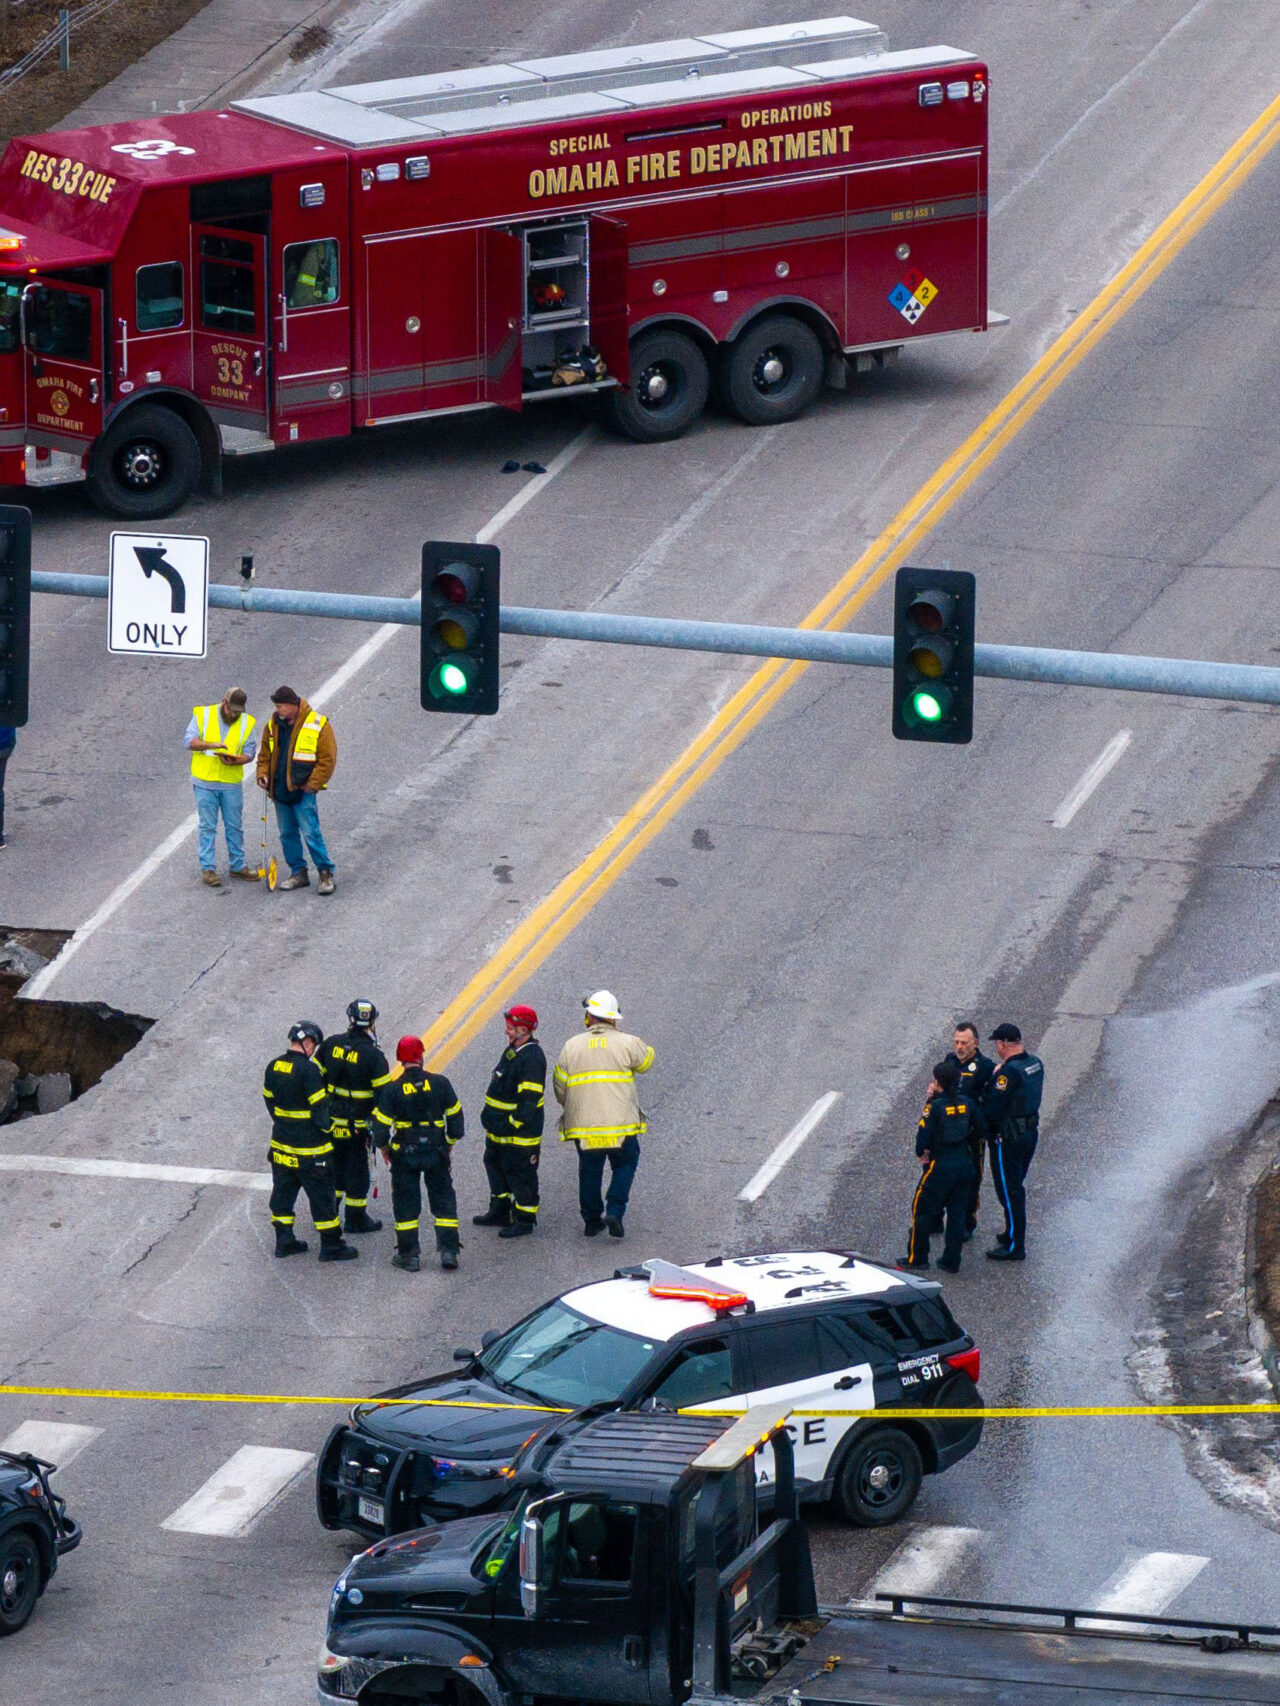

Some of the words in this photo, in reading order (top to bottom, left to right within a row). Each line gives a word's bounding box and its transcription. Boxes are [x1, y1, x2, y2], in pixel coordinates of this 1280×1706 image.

[549, 132, 612, 156] SPECIAL
[740, 101, 832, 129] OPERATIONS
[528, 159, 620, 199] OMAHA
[626, 150, 681, 184] FIRE
[690, 125, 854, 175] DEPARTMENT
[895, 291, 903, 302] 4
[921, 286, 930, 299] 2
[211, 342, 248, 361] RESCUE
[217, 357, 243, 385] 33
[36, 376, 65, 389] OMAHA
[66, 380, 84, 398] FIRE
[210, 385, 250, 401] COMPANY
[36, 412, 84, 432] DEPARTMENT
[126, 621, 188, 647] ONLY
[897, 1353, 940, 1372] EMERGENCY
[901, 1375, 920, 1386] DIAL
[921, 1363, 943, 1381] 911
